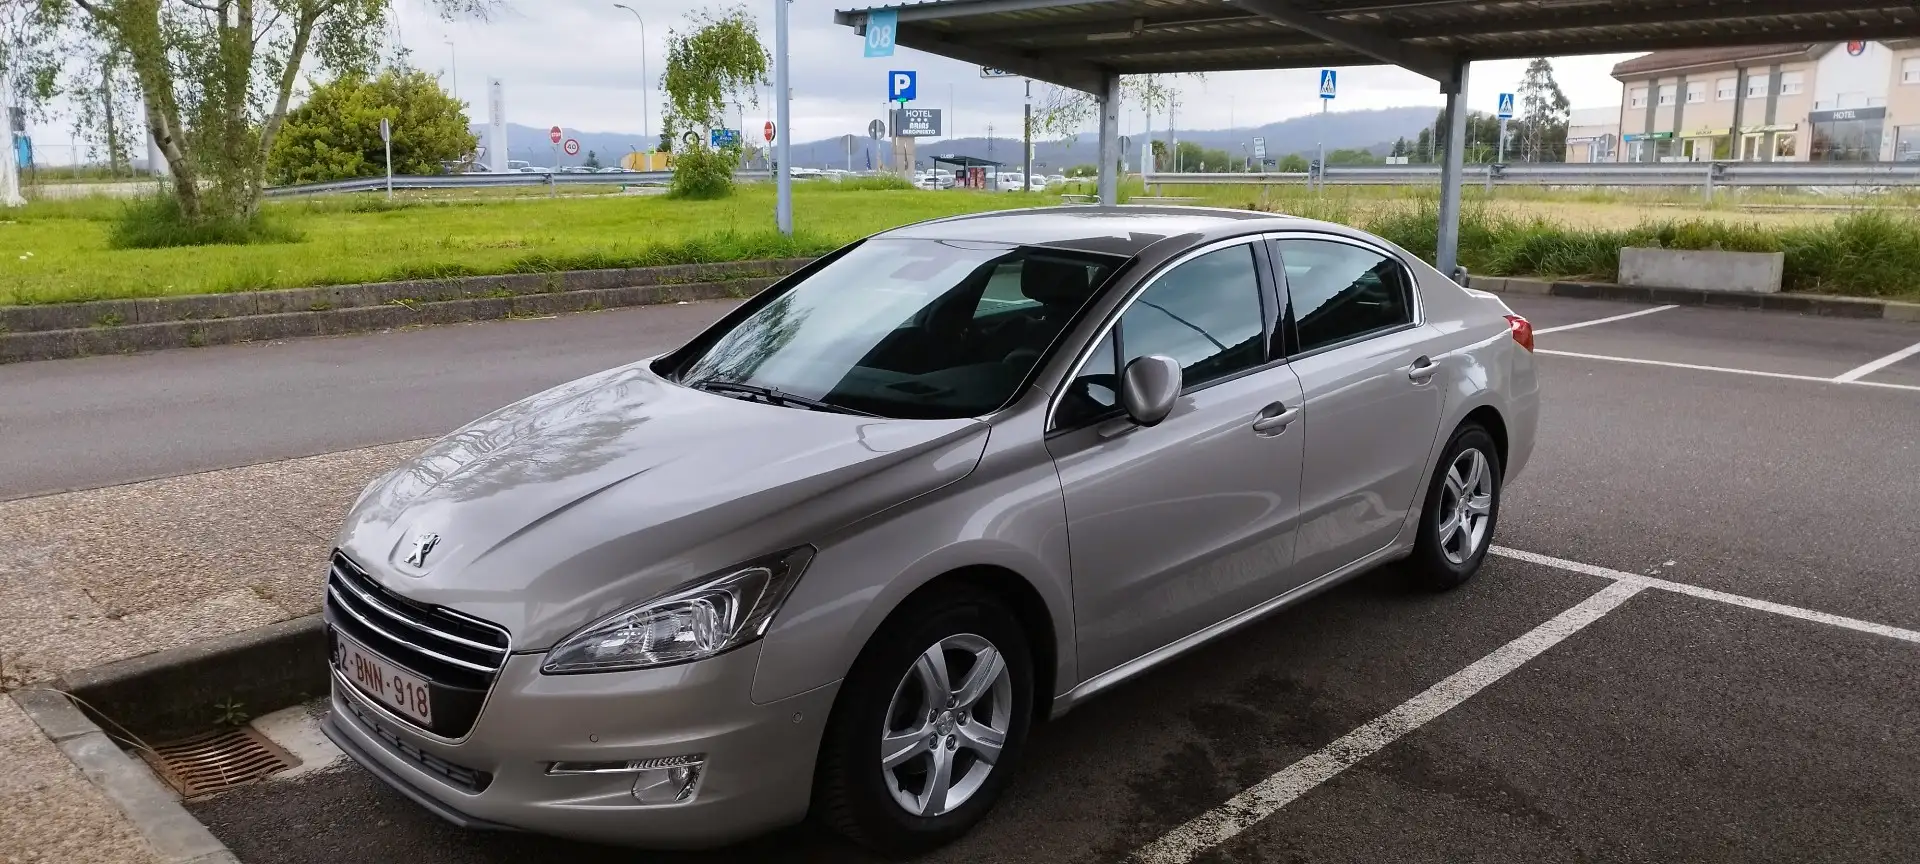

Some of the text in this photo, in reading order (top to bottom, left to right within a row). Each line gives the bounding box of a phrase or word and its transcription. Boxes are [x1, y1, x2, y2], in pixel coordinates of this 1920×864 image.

[869, 25, 891, 48] 08
[894, 74, 911, 96] P
[905, 110, 932, 118] HOTEL
[1833, 110, 1856, 120] HOTEL
[339, 642, 428, 717] 2-BNN-918
